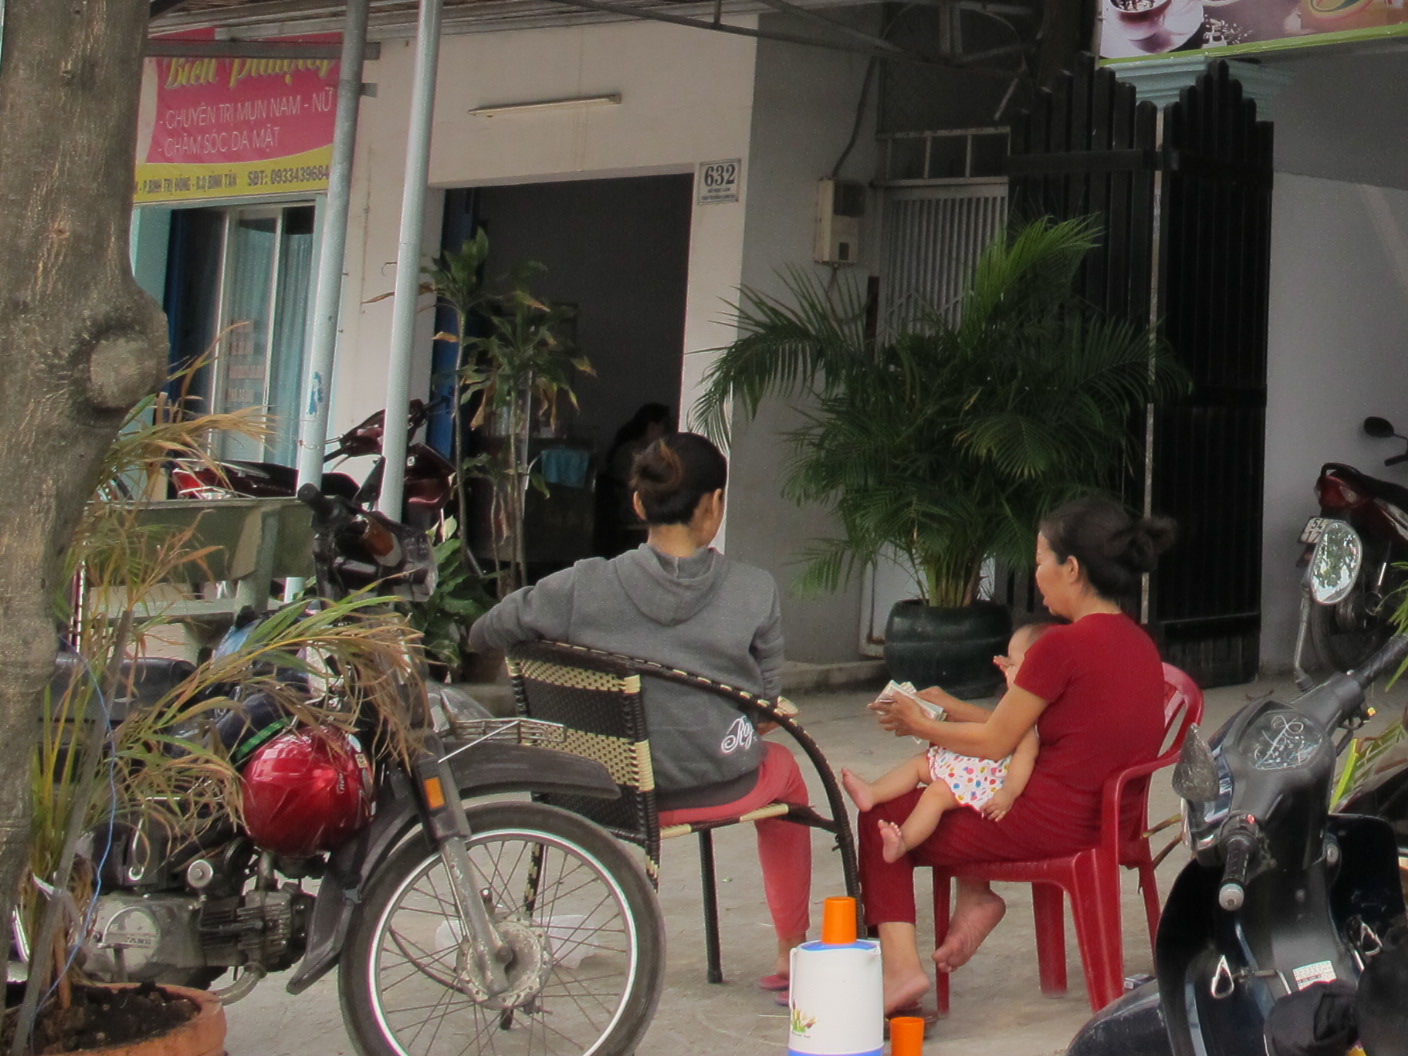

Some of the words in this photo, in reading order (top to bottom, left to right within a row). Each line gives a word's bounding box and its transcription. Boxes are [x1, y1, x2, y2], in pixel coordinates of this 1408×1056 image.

[165, 103, 216, 129] CHUYÊN
[219, 103, 235, 127] TRỊ
[236, 100, 267, 126] MỤN
[269, 95, 301, 116] NAM
[312, 87, 334, 112] NỮ
[164, 133, 202, 157] CHĂM
[203, 129, 229, 154] SÓC
[232, 132, 250, 151] DA
[252, 124, 281, 153] MẶT
[704, 164, 736, 186] 632
